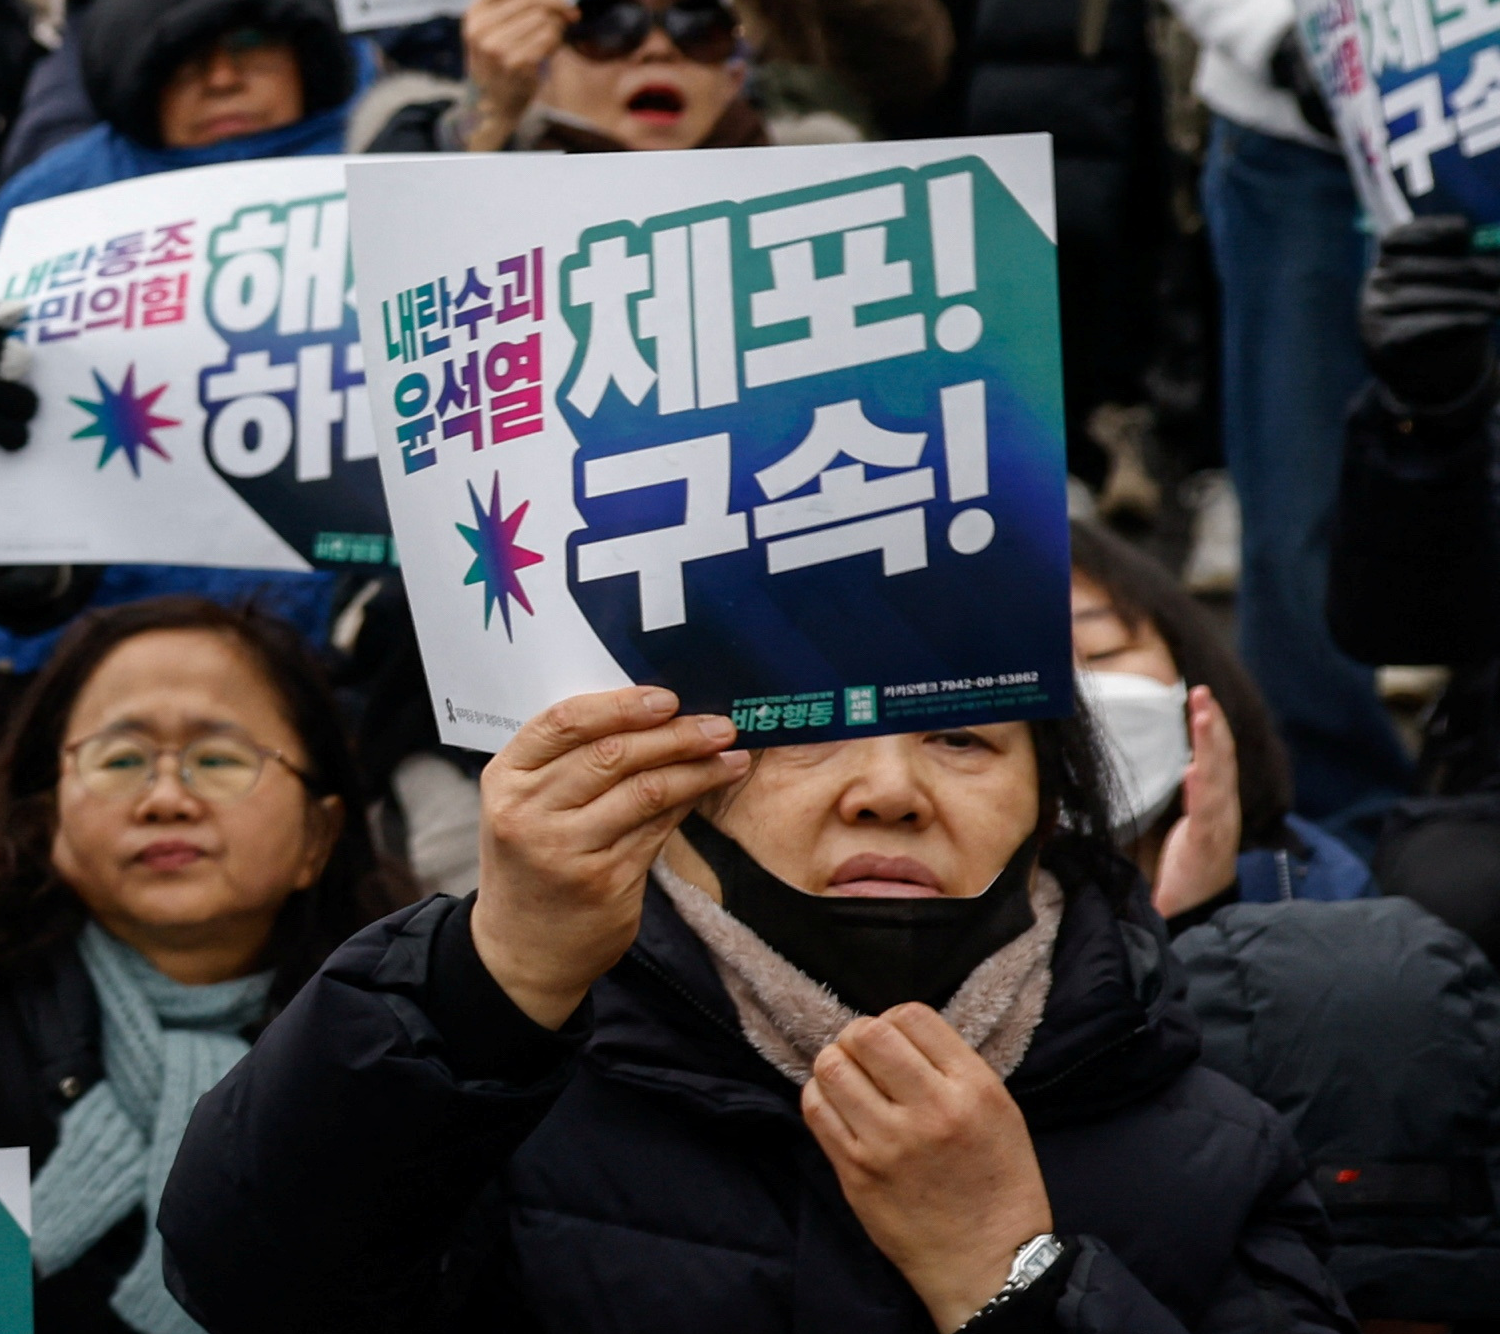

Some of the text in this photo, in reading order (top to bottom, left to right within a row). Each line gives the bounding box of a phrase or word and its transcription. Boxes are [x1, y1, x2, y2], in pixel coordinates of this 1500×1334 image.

[6, 218, 197, 299] 내란동조
[381, 246, 546, 369] 내란수괴
[566, 170, 984, 419] 체포!
[394, 332, 546, 476] 윤석열
[578, 378, 996, 633] 구속!
